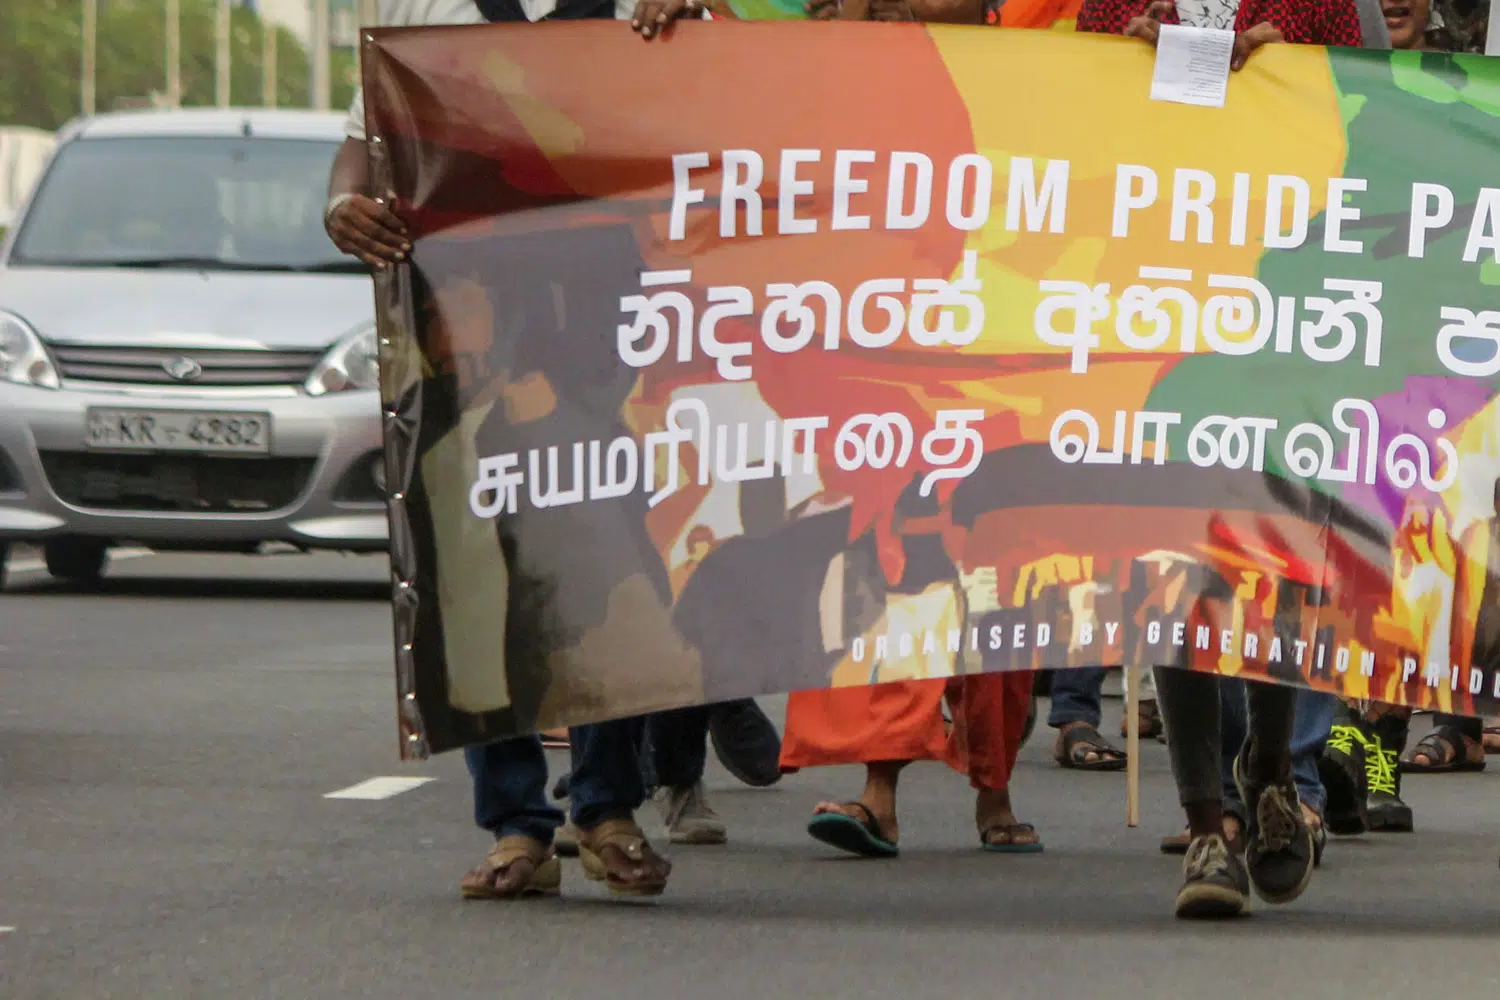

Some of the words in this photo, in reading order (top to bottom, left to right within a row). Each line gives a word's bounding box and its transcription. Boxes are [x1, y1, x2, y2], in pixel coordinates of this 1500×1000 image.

[669, 149, 1071, 240] FREEDOM
[1112, 163, 1368, 254] PRIDE
[617, 251, 985, 380] නිදහසේ
[469, 398, 985, 518] சுயமரியாதை
[1049, 398, 1458, 492] வானவில்
[852, 622, 1051, 662] ORGANISED
[1079, 622, 1119, 645] BY
[1147, 621, 1375, 677] GENERATION
